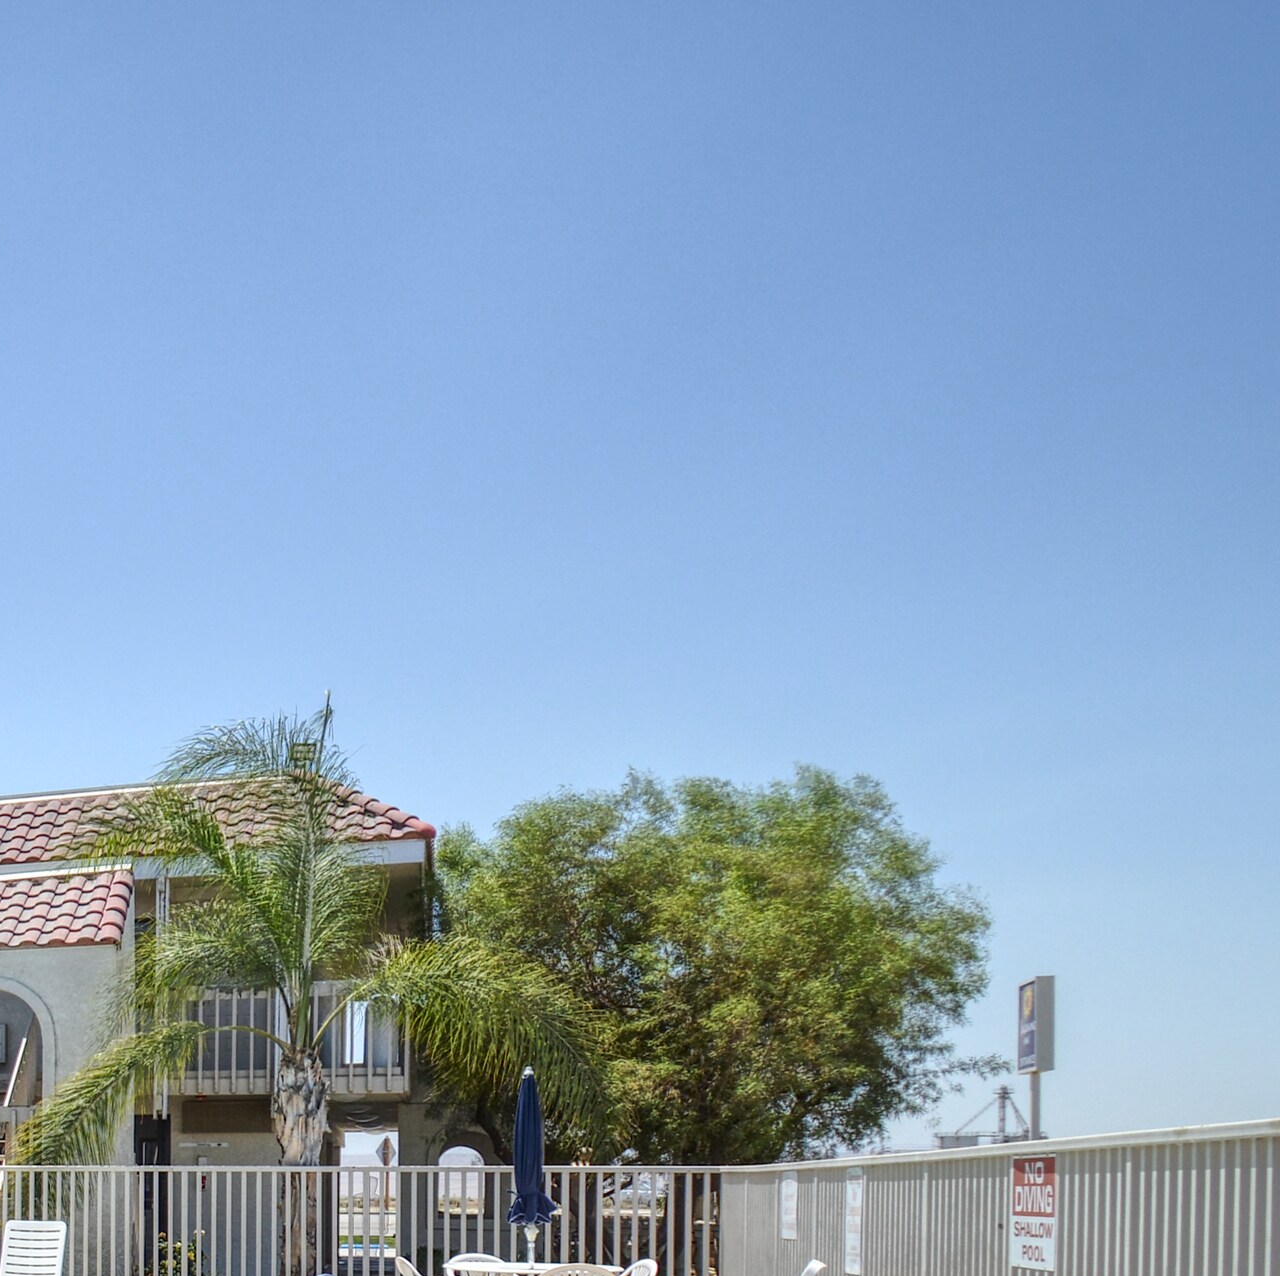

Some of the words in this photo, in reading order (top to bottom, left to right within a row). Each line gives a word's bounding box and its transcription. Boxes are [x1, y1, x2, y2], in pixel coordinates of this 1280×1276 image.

[1024, 1161, 1045, 1185] NO
[1015, 1185, 1054, 1213] DIVING
[1014, 1221, 1054, 1239] SHALLOW
[1022, 1245, 1046, 1262] POOL
